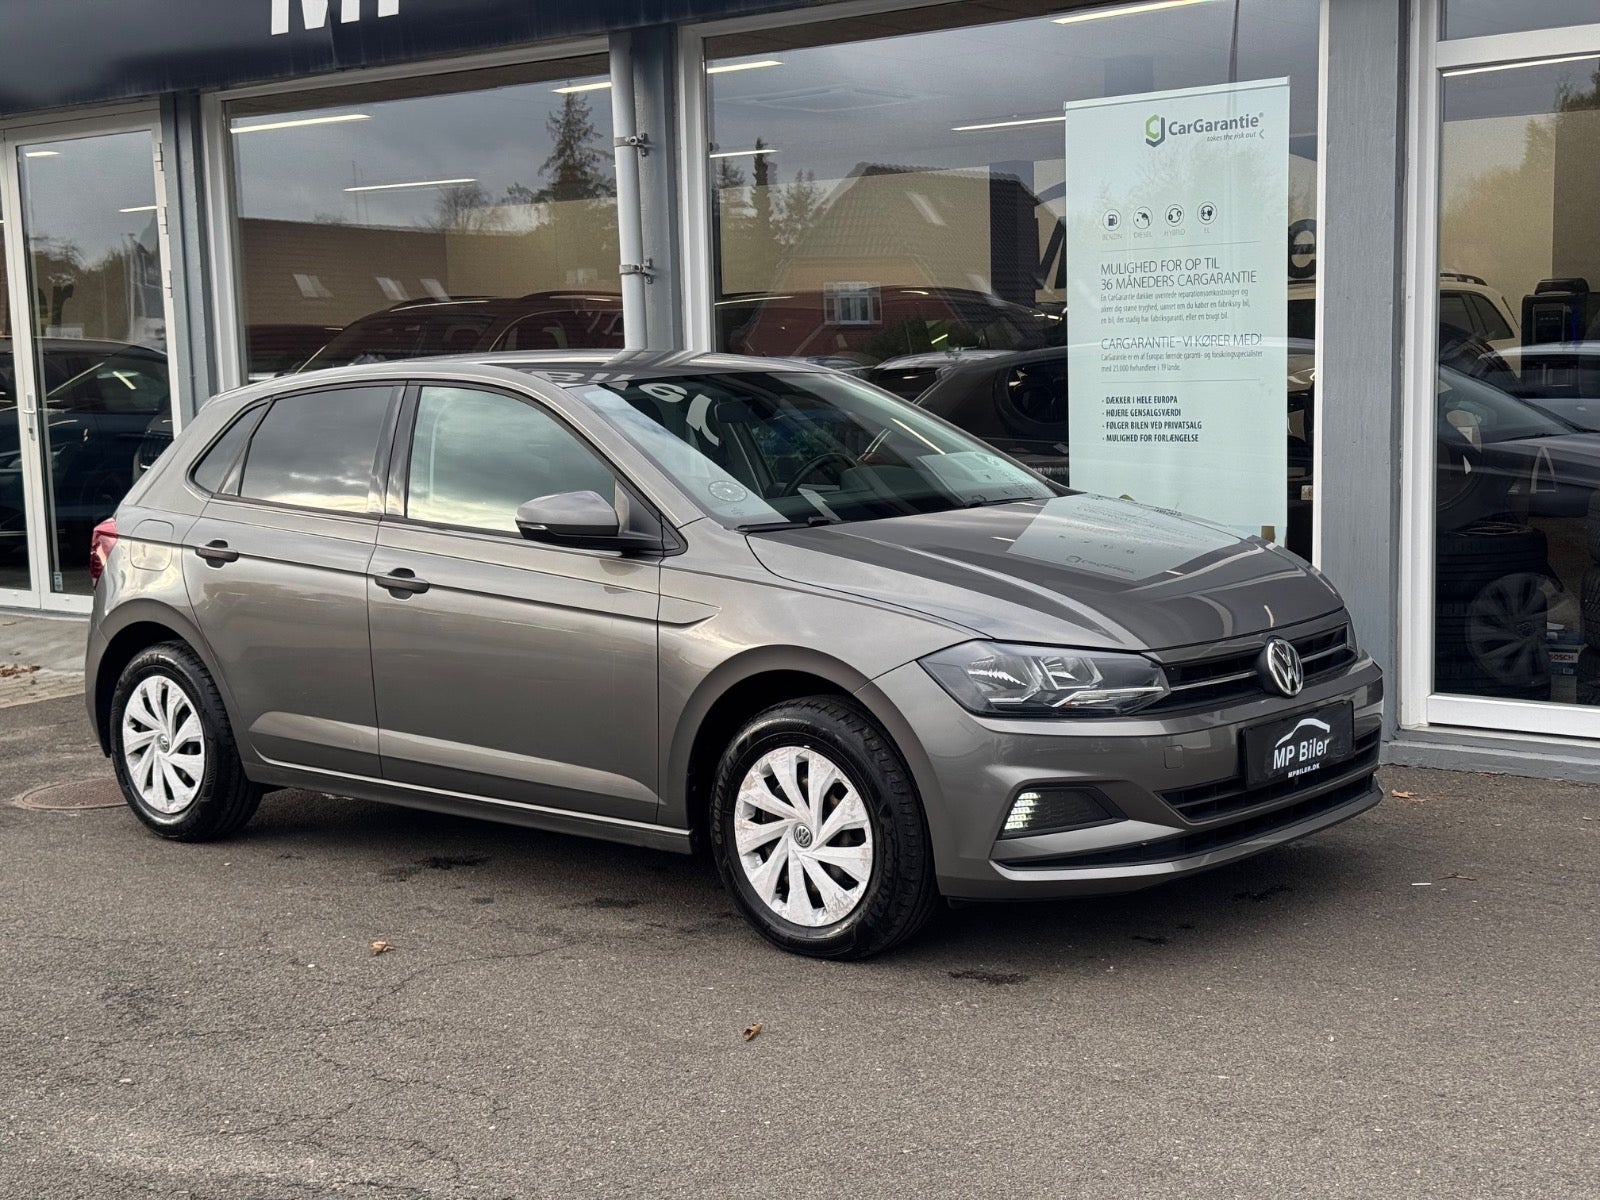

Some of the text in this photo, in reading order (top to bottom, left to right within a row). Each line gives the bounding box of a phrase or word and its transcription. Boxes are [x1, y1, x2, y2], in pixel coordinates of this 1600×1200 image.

[1223, 133, 1233, 141] the
[1101, 257, 1220, 275] MULIGHED FOR OP TIL
[1101, 270, 1257, 290] 36 MÅNEDERS CARGARANTIE
[1240, 288, 1249, 297] og
[1194, 333, 1230, 347] KØRER
[1233, 332, 1262, 346] MED!
[1106, 396, 1131, 405] DÆKKER
[1136, 395, 1152, 405] HELE
[1153, 395, 1178, 404] EUROPA
[1106, 408, 1181, 417] HØJERE GENSALGSVÆRDI
[1106, 420, 1202, 430] FØLGER BILEN VED PRIVATSALG
[1106, 433, 1199, 442] MULIGHED FOR FORLÆNGELSE
[1273, 737, 1330, 770] MP Biler
[1288, 763, 1320, 778] MPBILER.DK
